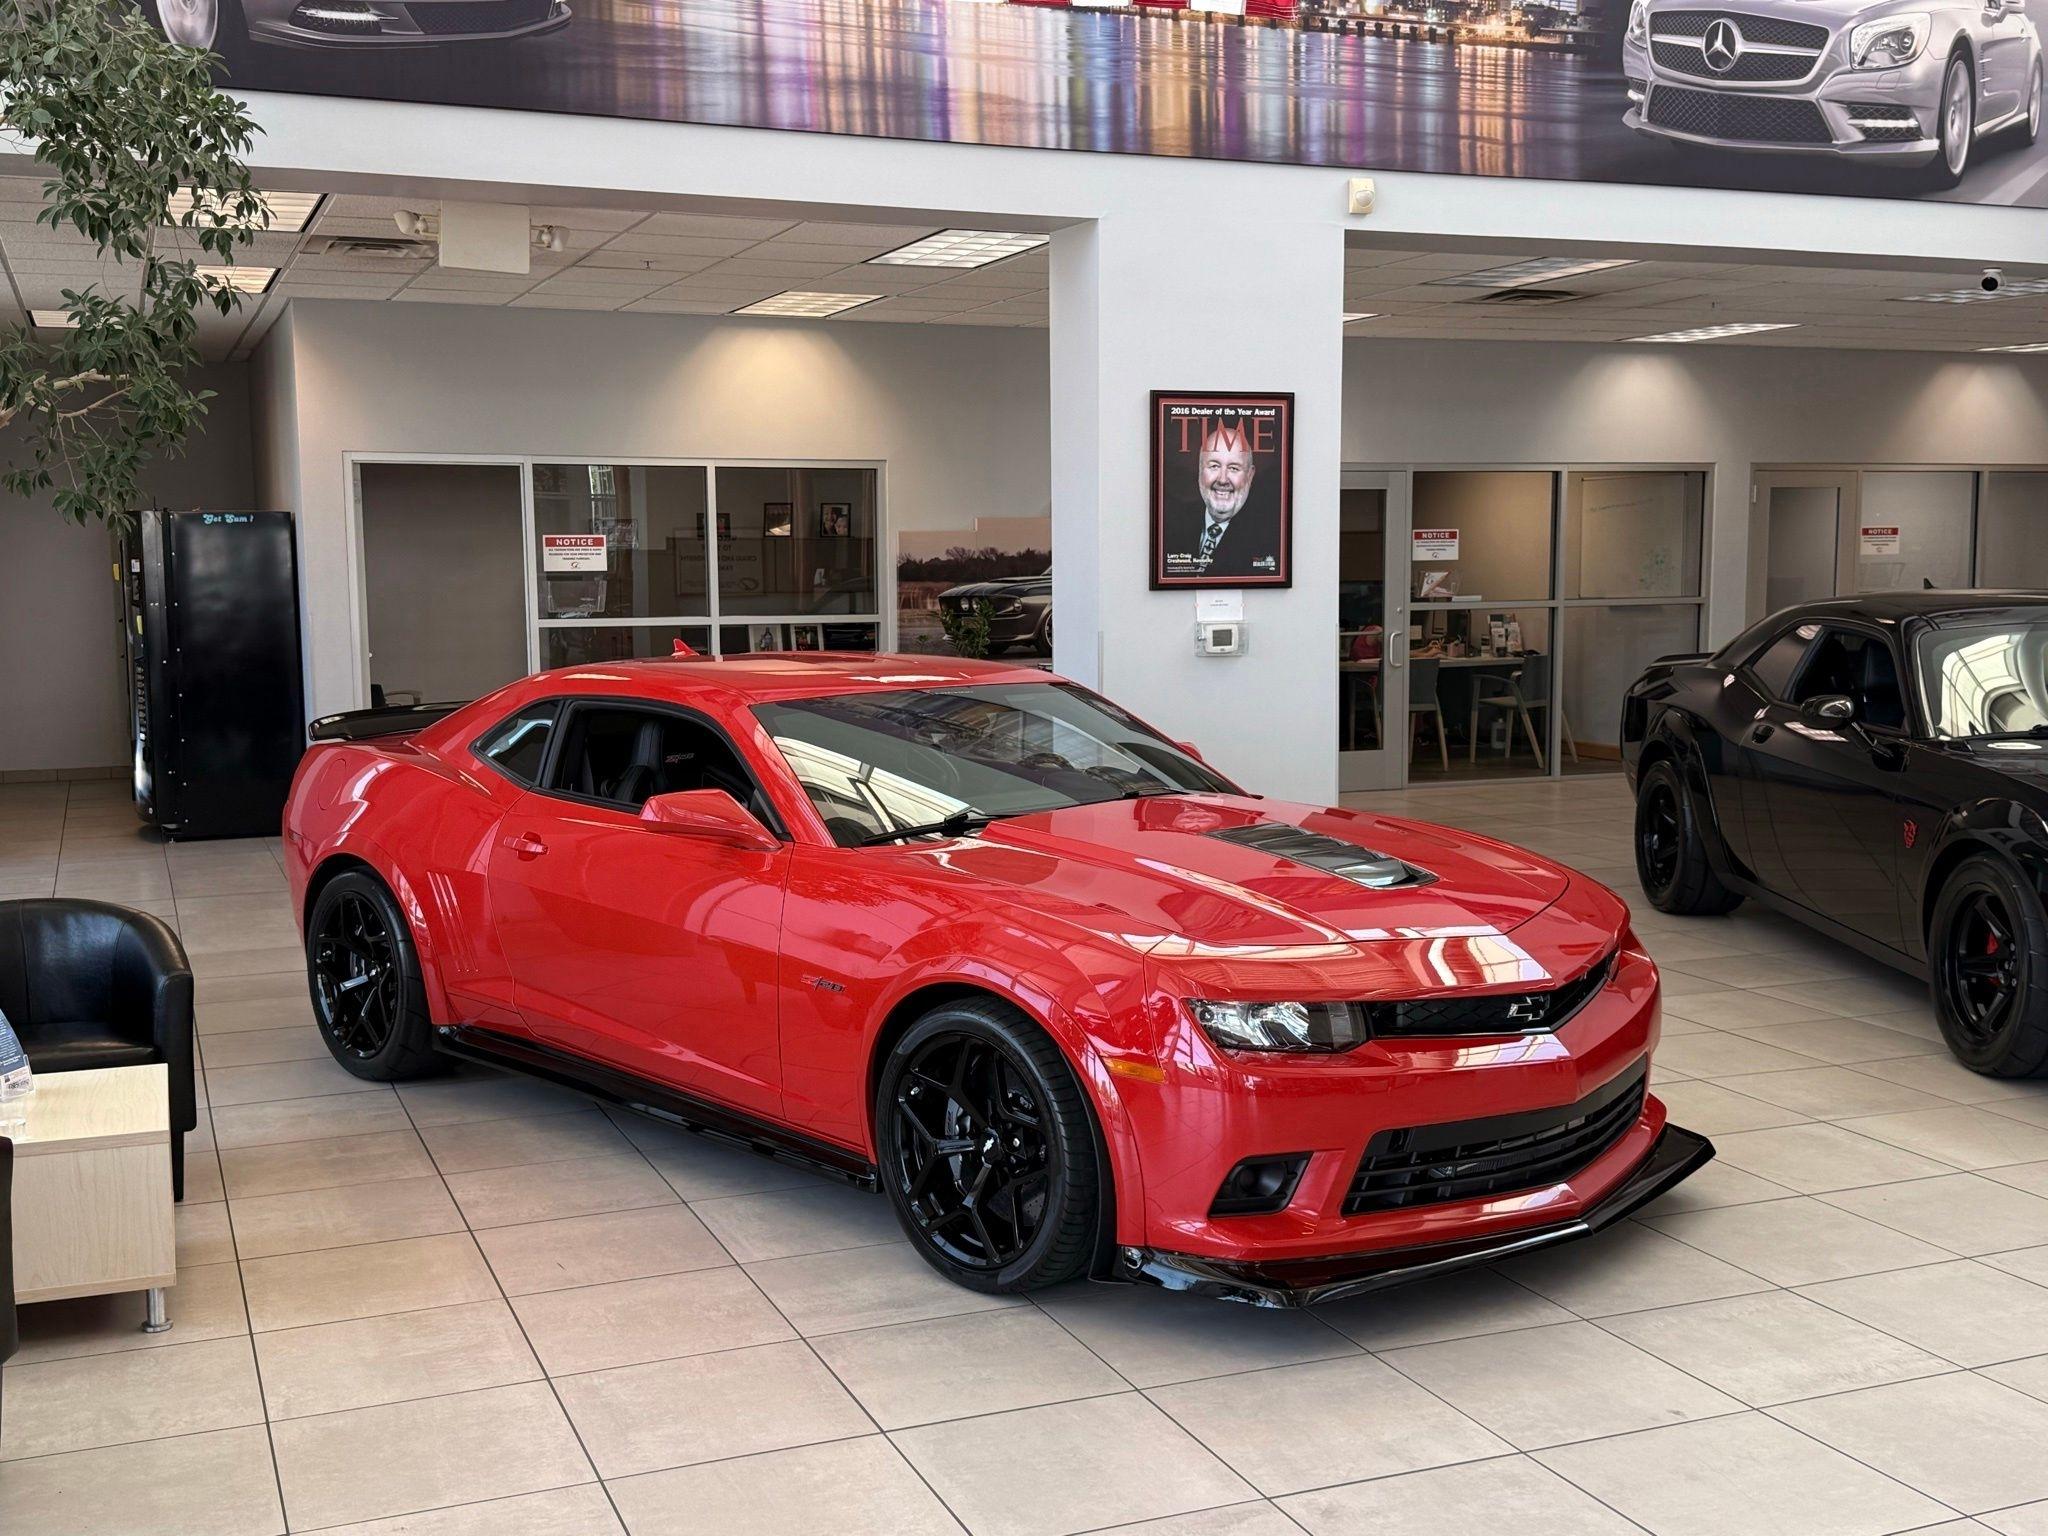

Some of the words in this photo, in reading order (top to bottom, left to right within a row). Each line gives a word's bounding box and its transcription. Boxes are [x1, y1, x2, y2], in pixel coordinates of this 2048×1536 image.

[1171, 407, 1190, 415] 2016
[1191, 407, 1213, 415] Dealer
[1237, 408, 1252, 416] Year
[1254, 408, 1275, 416] Award
[1171, 416, 1275, 453] TIME
[556, 538, 594, 546] NOTICE
